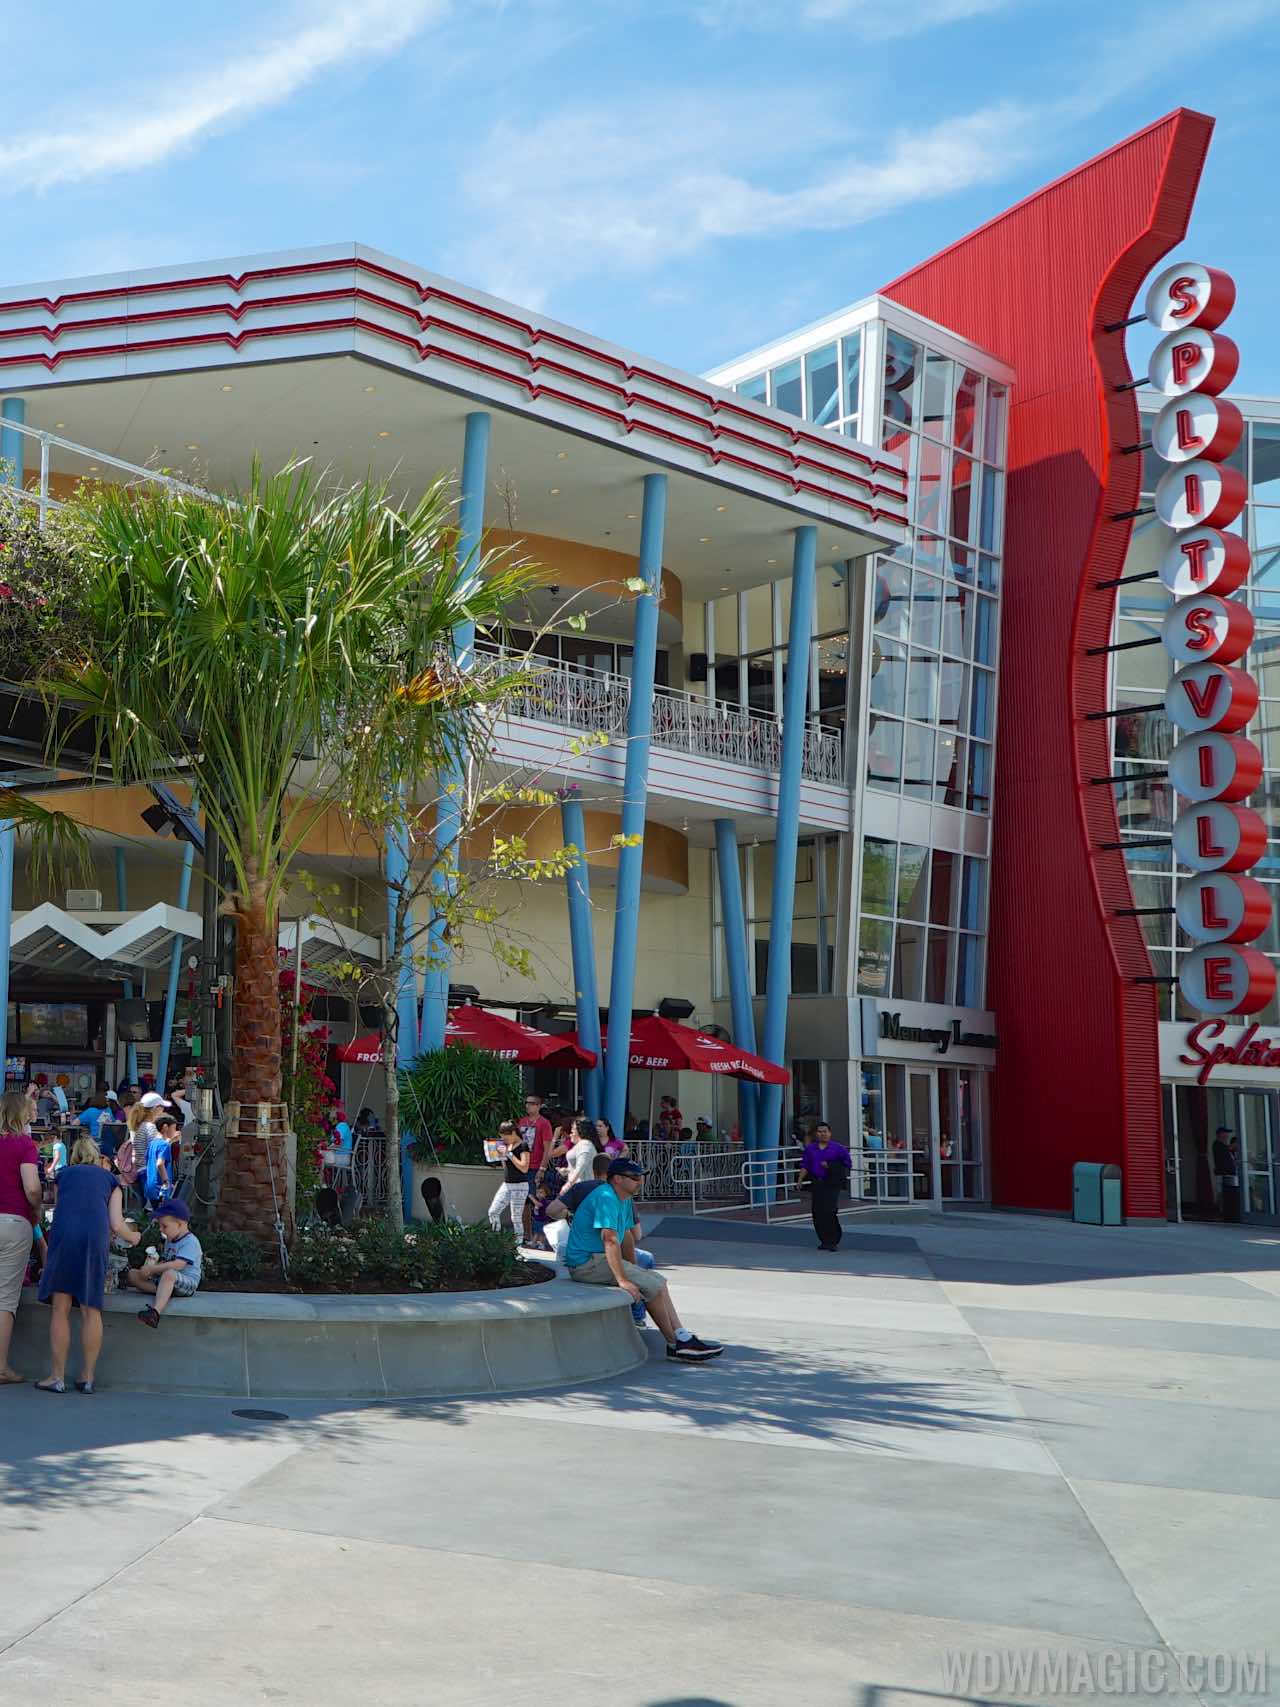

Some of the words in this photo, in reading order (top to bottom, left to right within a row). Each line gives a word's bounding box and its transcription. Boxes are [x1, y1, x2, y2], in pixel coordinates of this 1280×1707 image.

[1168, 276, 1234, 1000] SPLITSVILLE
[630, 1054, 645, 1065] OF
[646, 1056, 670, 1067] BEER
